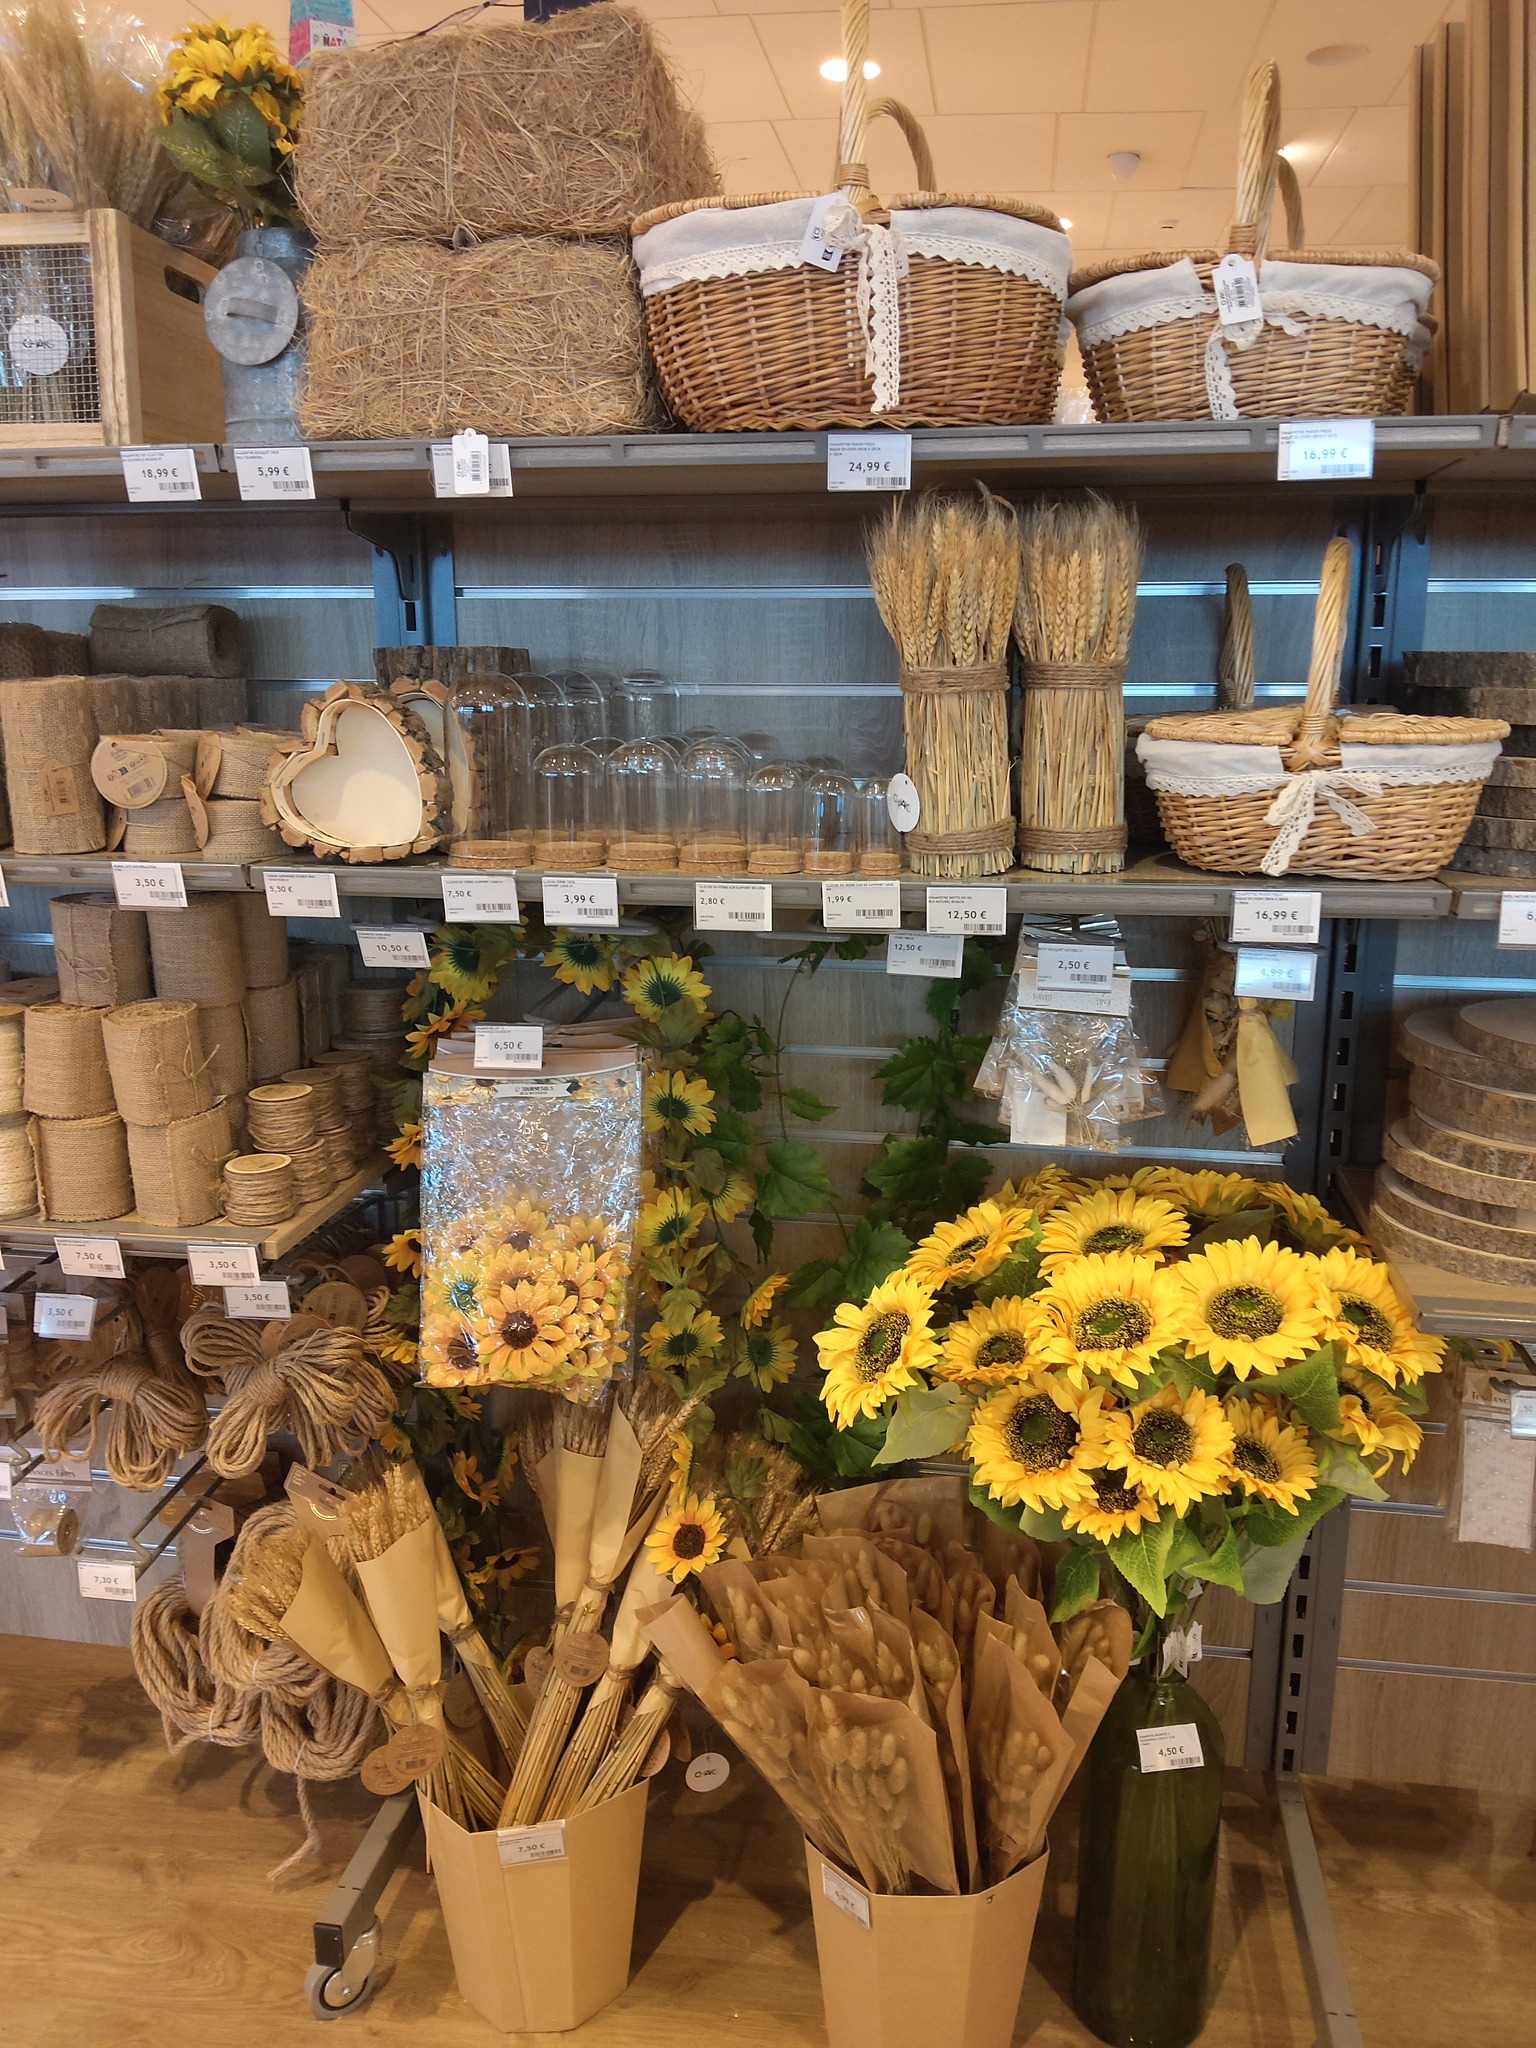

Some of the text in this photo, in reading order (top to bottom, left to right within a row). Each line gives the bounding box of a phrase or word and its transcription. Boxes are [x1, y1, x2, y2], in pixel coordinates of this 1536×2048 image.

[1303, 448, 1348, 461] 16,99 €
[258, 466, 290, 477] 5,99 €
[849, 461, 891, 473] 24,99 €
[142, 467, 179, 479] 18,99 €
[135, 878, 165, 888] 3,50 €
[269, 885, 287, 894] 5,50
[447, 890, 465, 899] 7,50
[564, 894, 595, 905] 3,99 €
[700, 897, 718, 906] 2,80
[827, 895, 852, 904] 1,99 €
[947, 910, 987, 921] 12,50 €
[1255, 910, 1299, 922] 16,99 €
[376, 944, 410, 953] 10,50 €
[894, 943, 923, 952] 12,50 €
[1057, 960, 1090, 971] 2,50 €
[494, 1041, 523, 1051] 6,50 €
[75, 1252, 103, 1261] 7,50 €
[209, 1260, 238, 1270] 3,50 €
[243, 1293, 271, 1302] 3,50 €
[48, 1307, 74, 1318] 3,50 €
[1471, 1390, 1509, 1404] TENDANC
[94, 1575, 119, 1585] 7,30 €
[1158, 1745, 1185, 1758] 4,50 €
[518, 1844, 538, 1854] 7,50
